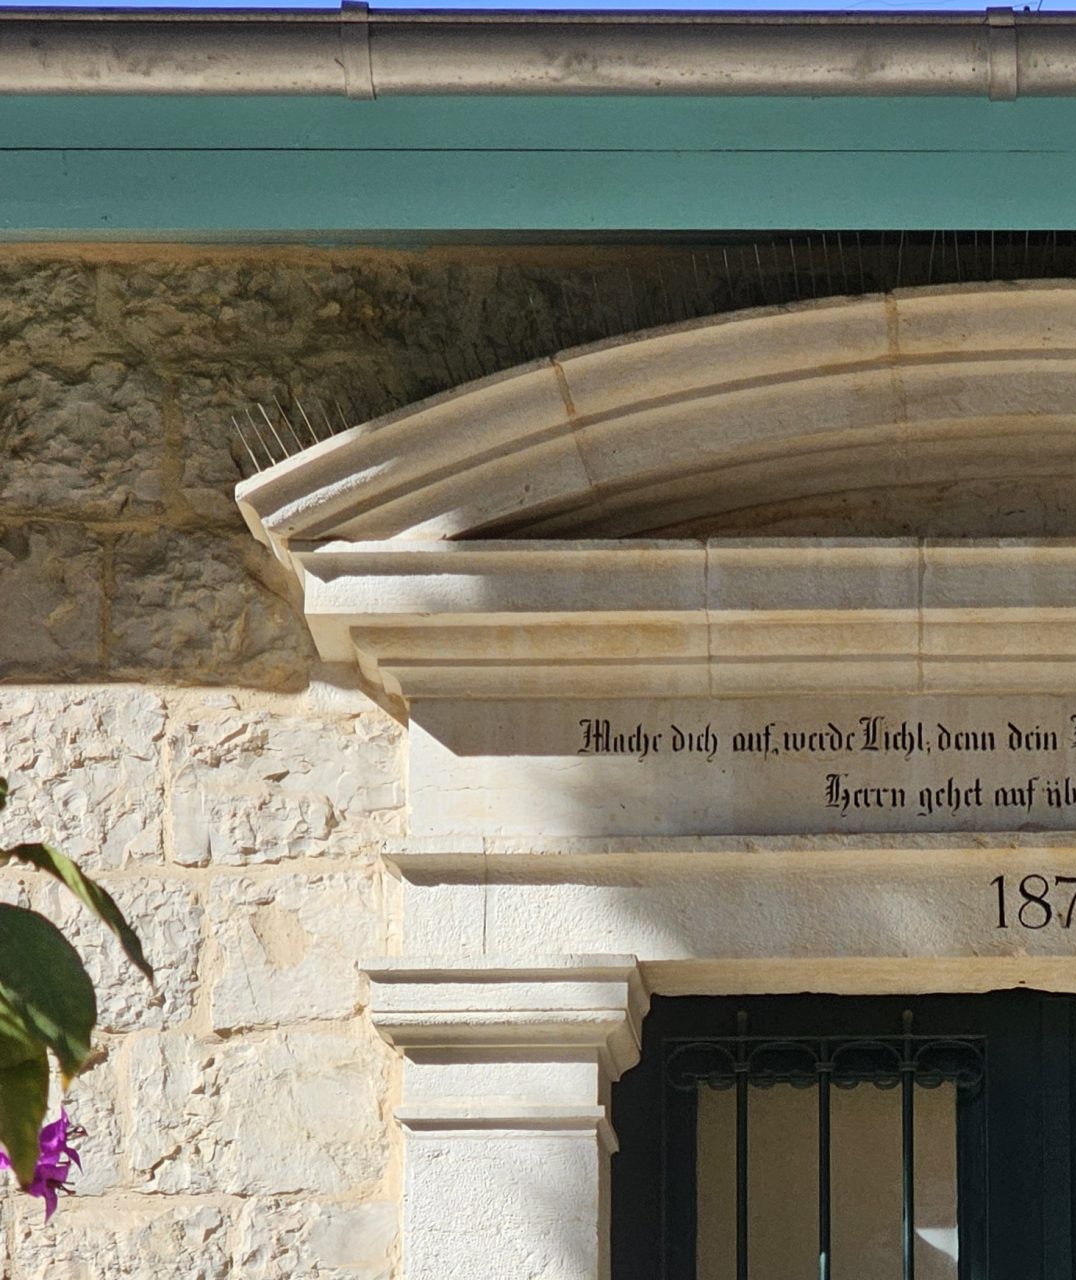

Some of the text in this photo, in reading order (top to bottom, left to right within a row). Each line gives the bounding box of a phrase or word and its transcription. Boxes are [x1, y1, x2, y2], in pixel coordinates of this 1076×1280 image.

[577, 719, 662, 762] Mache
[671, 723, 718, 762] dich
[937, 723, 995, 751] denn
[1007, 722, 1057, 751] dein
[824, 773, 905, 817] Herrn
[917, 777, 982, 816] gehet
[994, 776, 1040, 813] auf
